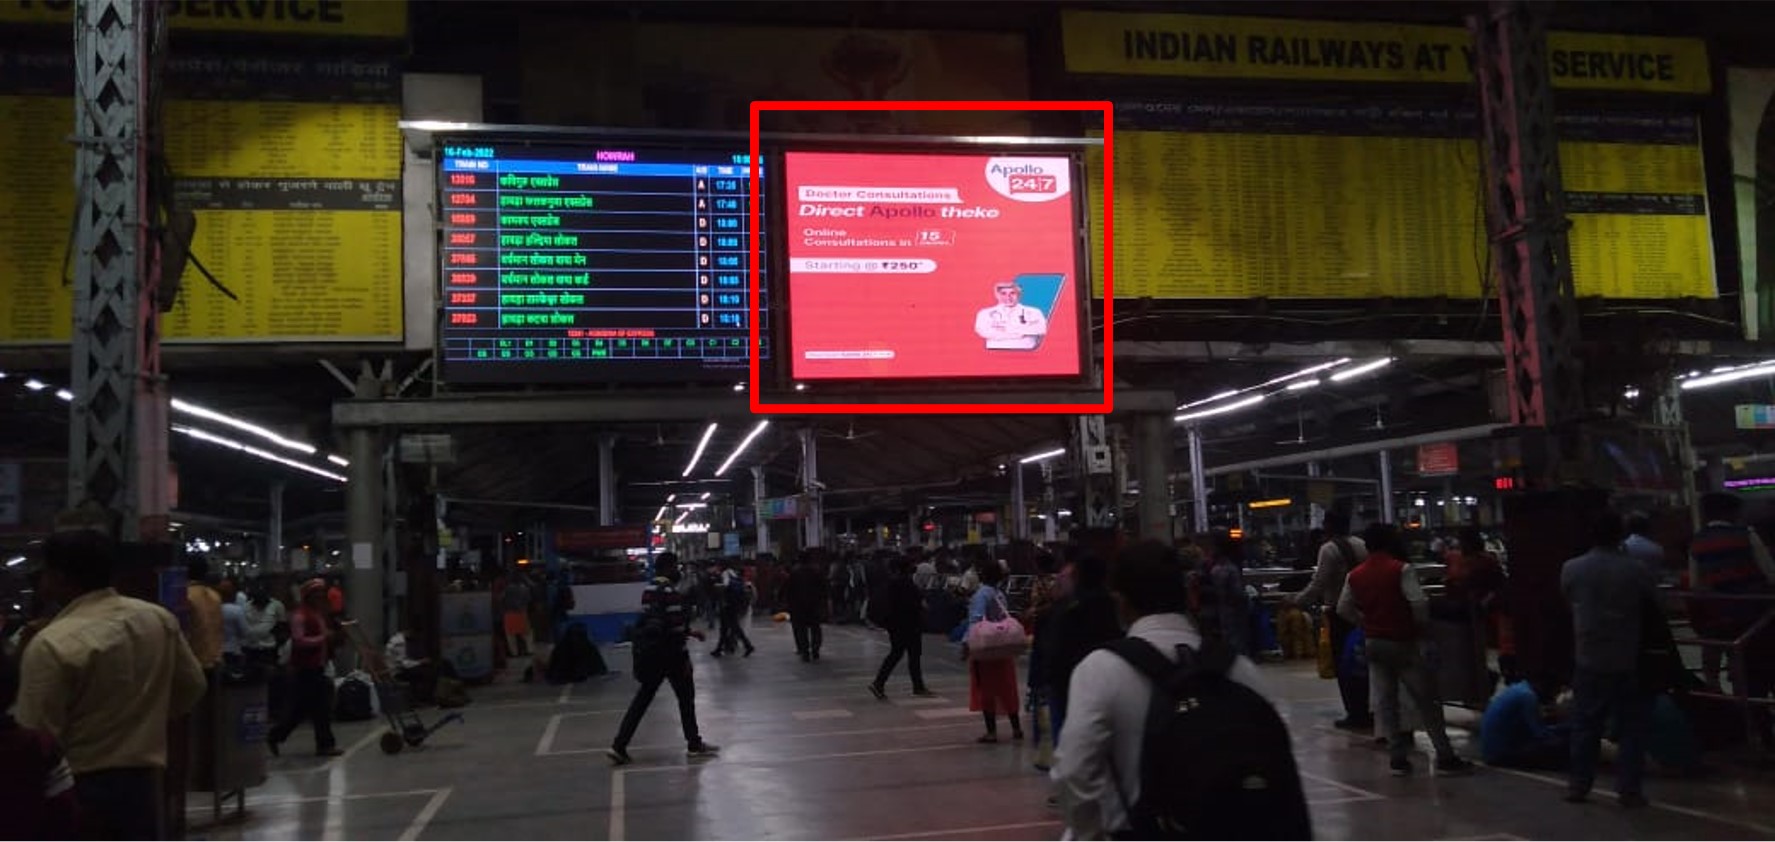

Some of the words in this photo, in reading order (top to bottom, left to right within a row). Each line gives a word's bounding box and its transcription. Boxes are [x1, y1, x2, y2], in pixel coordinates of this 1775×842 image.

[1123, 29, 1236, 64] INDIAN
[1247, 35, 1404, 71] RAILWAYS
[1414, 42, 1450, 71] AT
[1552, 50, 1674, 81] SERVICE
[444, 147, 494, 158] 16-Feb-2022
[597, 150, 635, 162] HOWRAH
[991, 164, 1043, 178] Apollo
[697, 180, 706, 190] A
[805, 189, 852, 199] Doctor
[856, 189, 951, 200] Consultations
[698, 199, 706, 209] A
[799, 203, 864, 218] Direct
[870, 205, 936, 219] Apollo
[940, 206, 1000, 218] theke
[699, 217, 707, 228] D
[803, 228, 847, 236] Online
[699, 236, 708, 247] D
[804, 238, 896, 248] Consultations
[899, 239, 912, 247] in
[920, 231, 940, 241] 15
[700, 256, 708, 266] D
[805, 260, 861, 271] Starting
[700, 275, 709, 285] D
[701, 294, 709, 305] D
[701, 313, 710, 324] D
